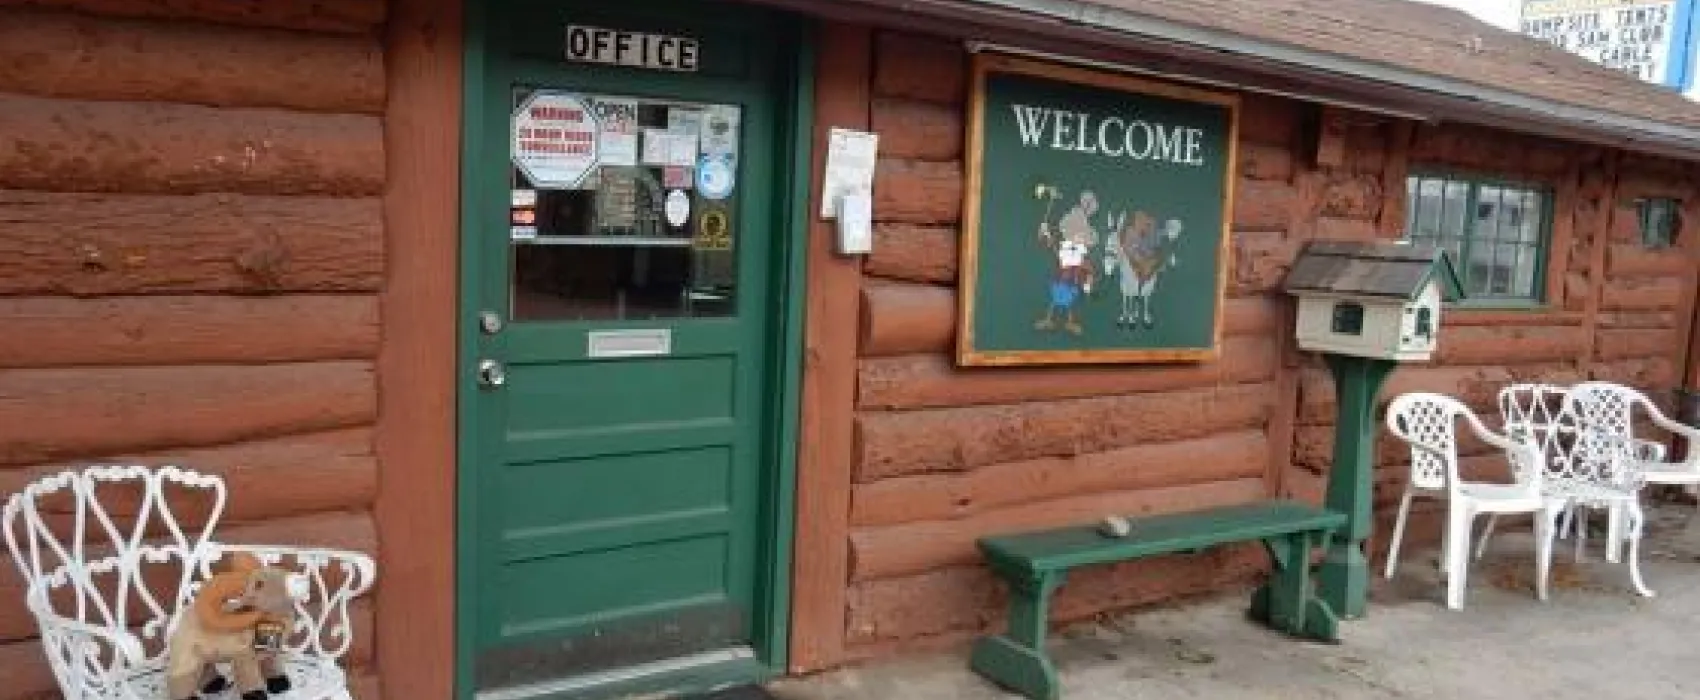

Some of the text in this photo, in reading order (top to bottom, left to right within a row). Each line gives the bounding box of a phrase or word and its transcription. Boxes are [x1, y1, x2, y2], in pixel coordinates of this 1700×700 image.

[570, 27, 698, 69] OFFICE
[530, 106, 584, 123] WARNING
[596, 100, 636, 120] OPEN
[1011, 104, 1204, 166] WELCOME
